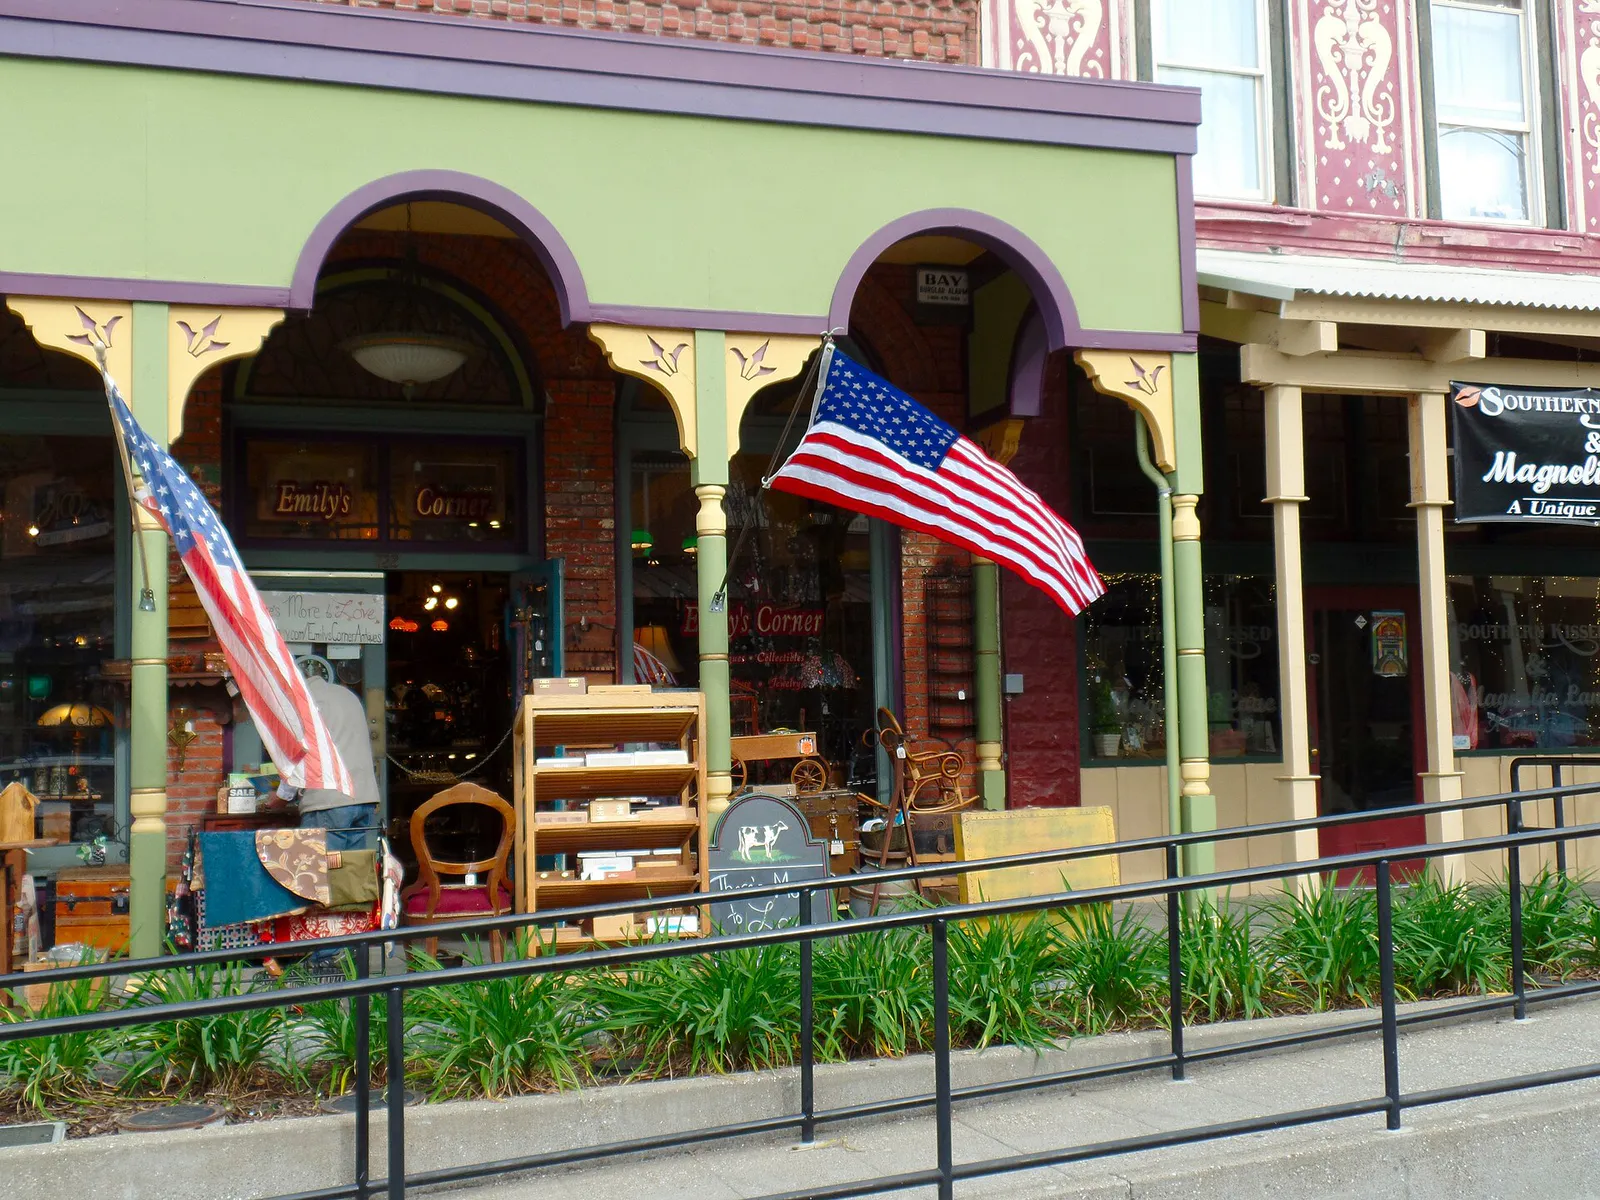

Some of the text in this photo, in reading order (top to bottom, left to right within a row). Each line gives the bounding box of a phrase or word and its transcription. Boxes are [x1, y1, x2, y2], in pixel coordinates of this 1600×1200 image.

[925, 273, 962, 286] BAY
[1480, 387, 1600, 416] SOUTHERN
[276, 485, 490, 519] Emily's Corner
[1507, 500, 1596, 518] A Unique
[283, 595, 320, 619] More
[684, 606, 822, 637] Ey's Corner
[756, 651, 805, 664] Collectibles
[229, 788, 255, 797] SALE
[727, 903, 743, 925] to
